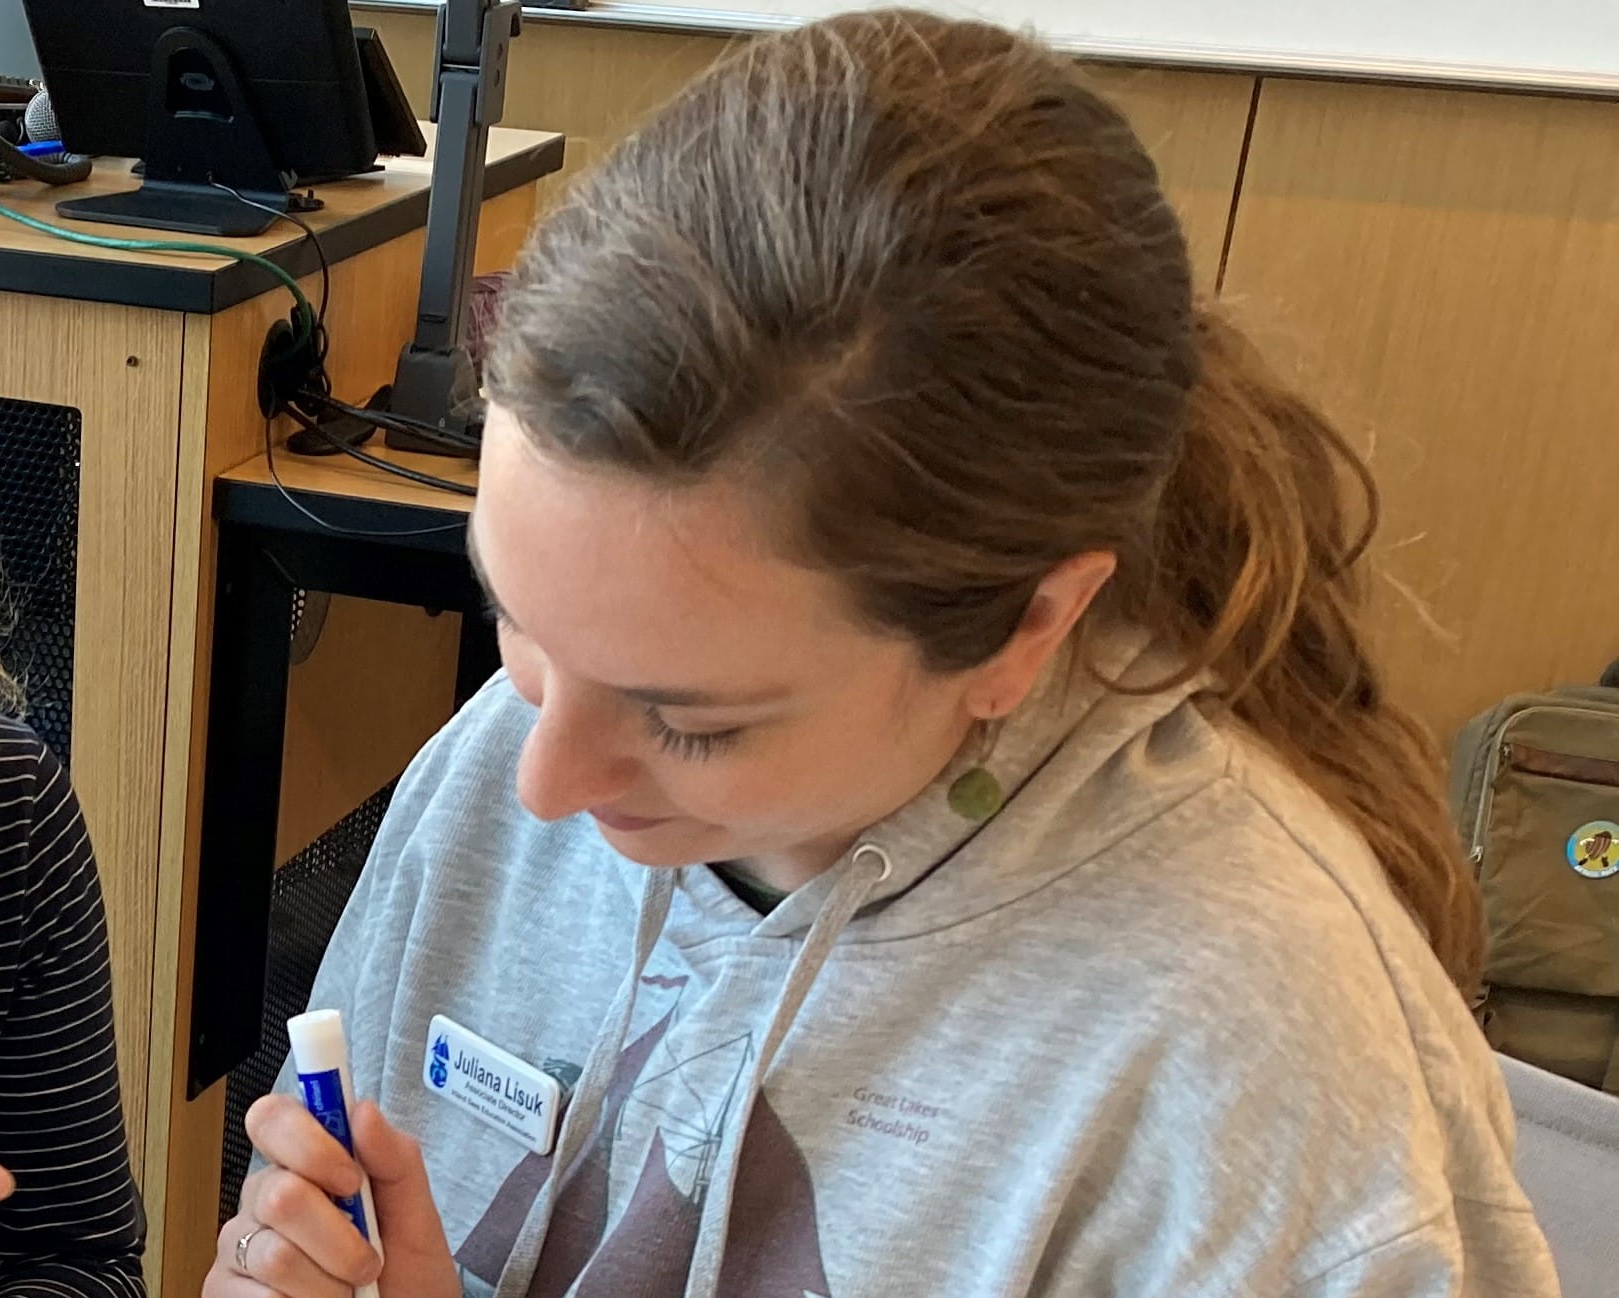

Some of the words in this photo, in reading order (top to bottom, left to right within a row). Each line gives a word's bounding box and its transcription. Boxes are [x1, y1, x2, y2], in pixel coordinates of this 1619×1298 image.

[454, 1050, 502, 1093] Juliana
[504, 1077, 544, 1117] Lisuk
[853, 1087, 899, 1109] Great
[899, 1096, 941, 1118] Lakes
[846, 1108, 931, 1146] Schoolship
